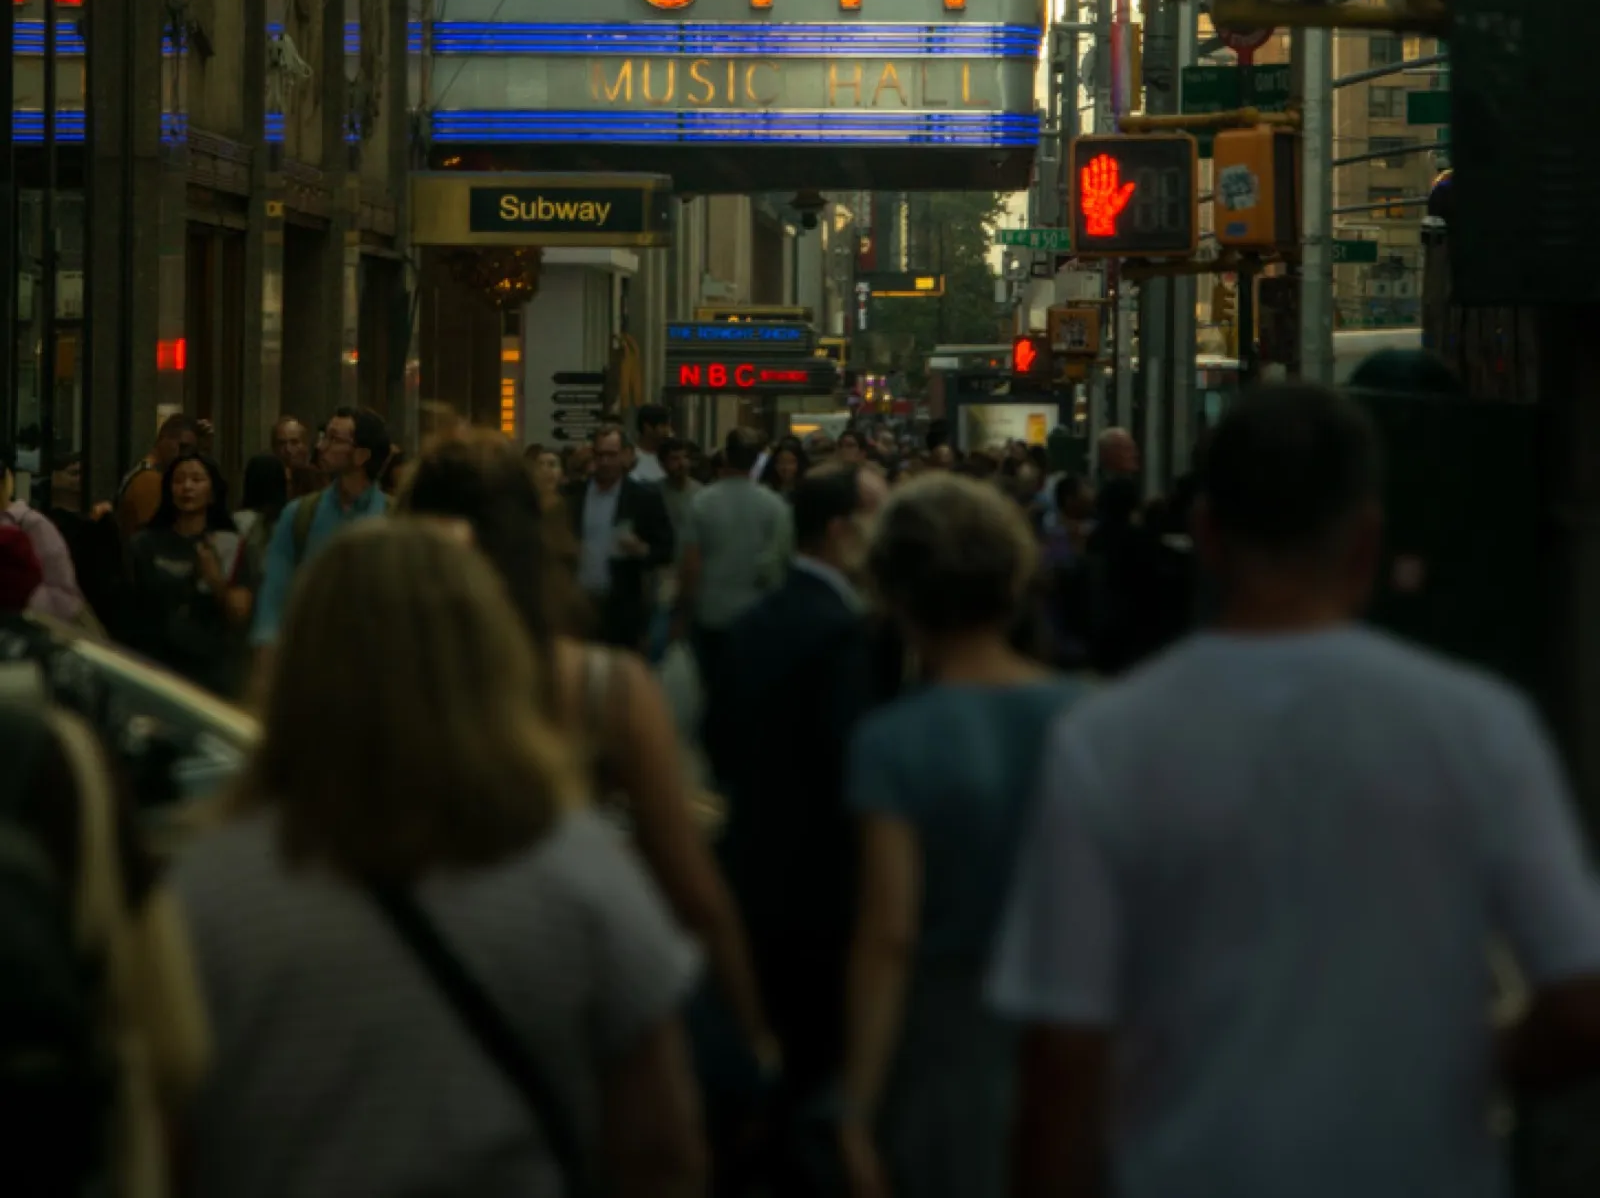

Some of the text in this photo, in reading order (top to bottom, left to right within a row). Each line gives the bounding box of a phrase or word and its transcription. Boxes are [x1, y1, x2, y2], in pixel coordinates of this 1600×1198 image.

[591, 59, 992, 107] MUSIC HALL
[499, 193, 612, 226] Subway
[679, 362, 756, 388] NBC
